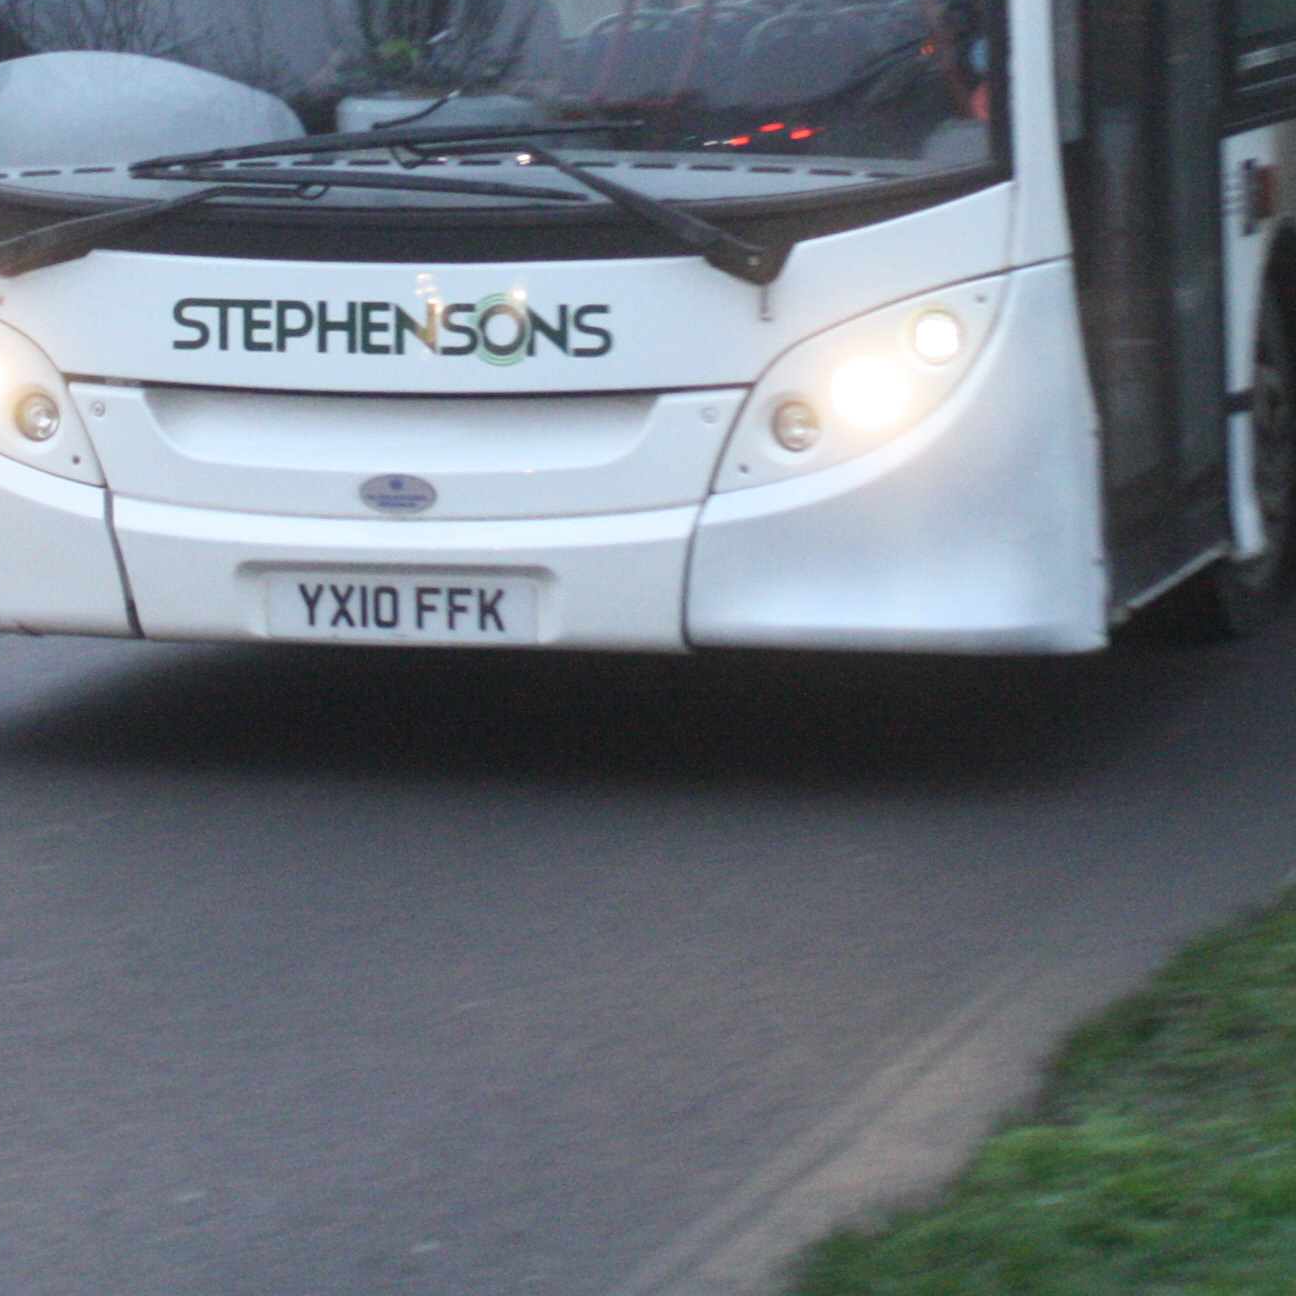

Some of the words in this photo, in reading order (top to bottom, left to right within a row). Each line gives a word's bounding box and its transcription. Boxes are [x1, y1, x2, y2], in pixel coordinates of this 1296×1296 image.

[172, 297, 614, 359] STEPHENSONS
[298, 583, 400, 630] YX10
[414, 586, 506, 633] FFK
